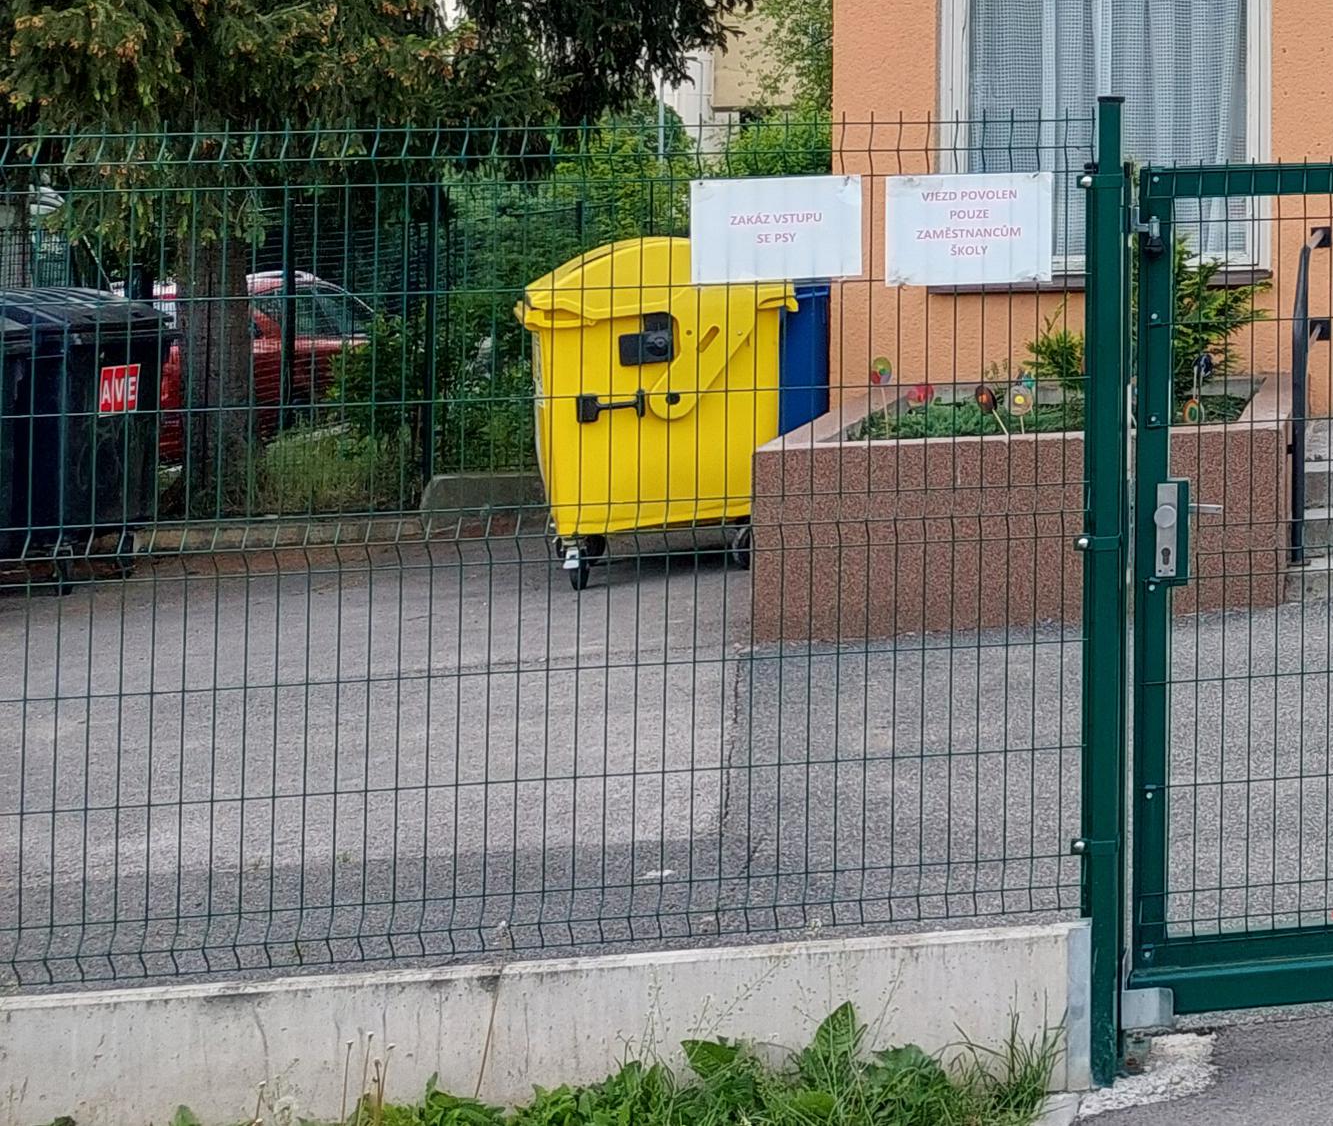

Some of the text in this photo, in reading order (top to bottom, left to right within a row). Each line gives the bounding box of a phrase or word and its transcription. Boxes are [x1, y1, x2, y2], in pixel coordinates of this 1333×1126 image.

[921, 189, 1017, 202] VJEZD POVOLEN
[730, 211, 823, 226] ZAKÁZ VSTUPU
[949, 209, 990, 220] POUZE
[756, 232, 797, 244] SE PSY
[916, 224, 1022, 240] ZAMĚSTNANCŮM
[950, 243, 989, 256] ŠKOLY
[101, 376, 137, 404] AVE
